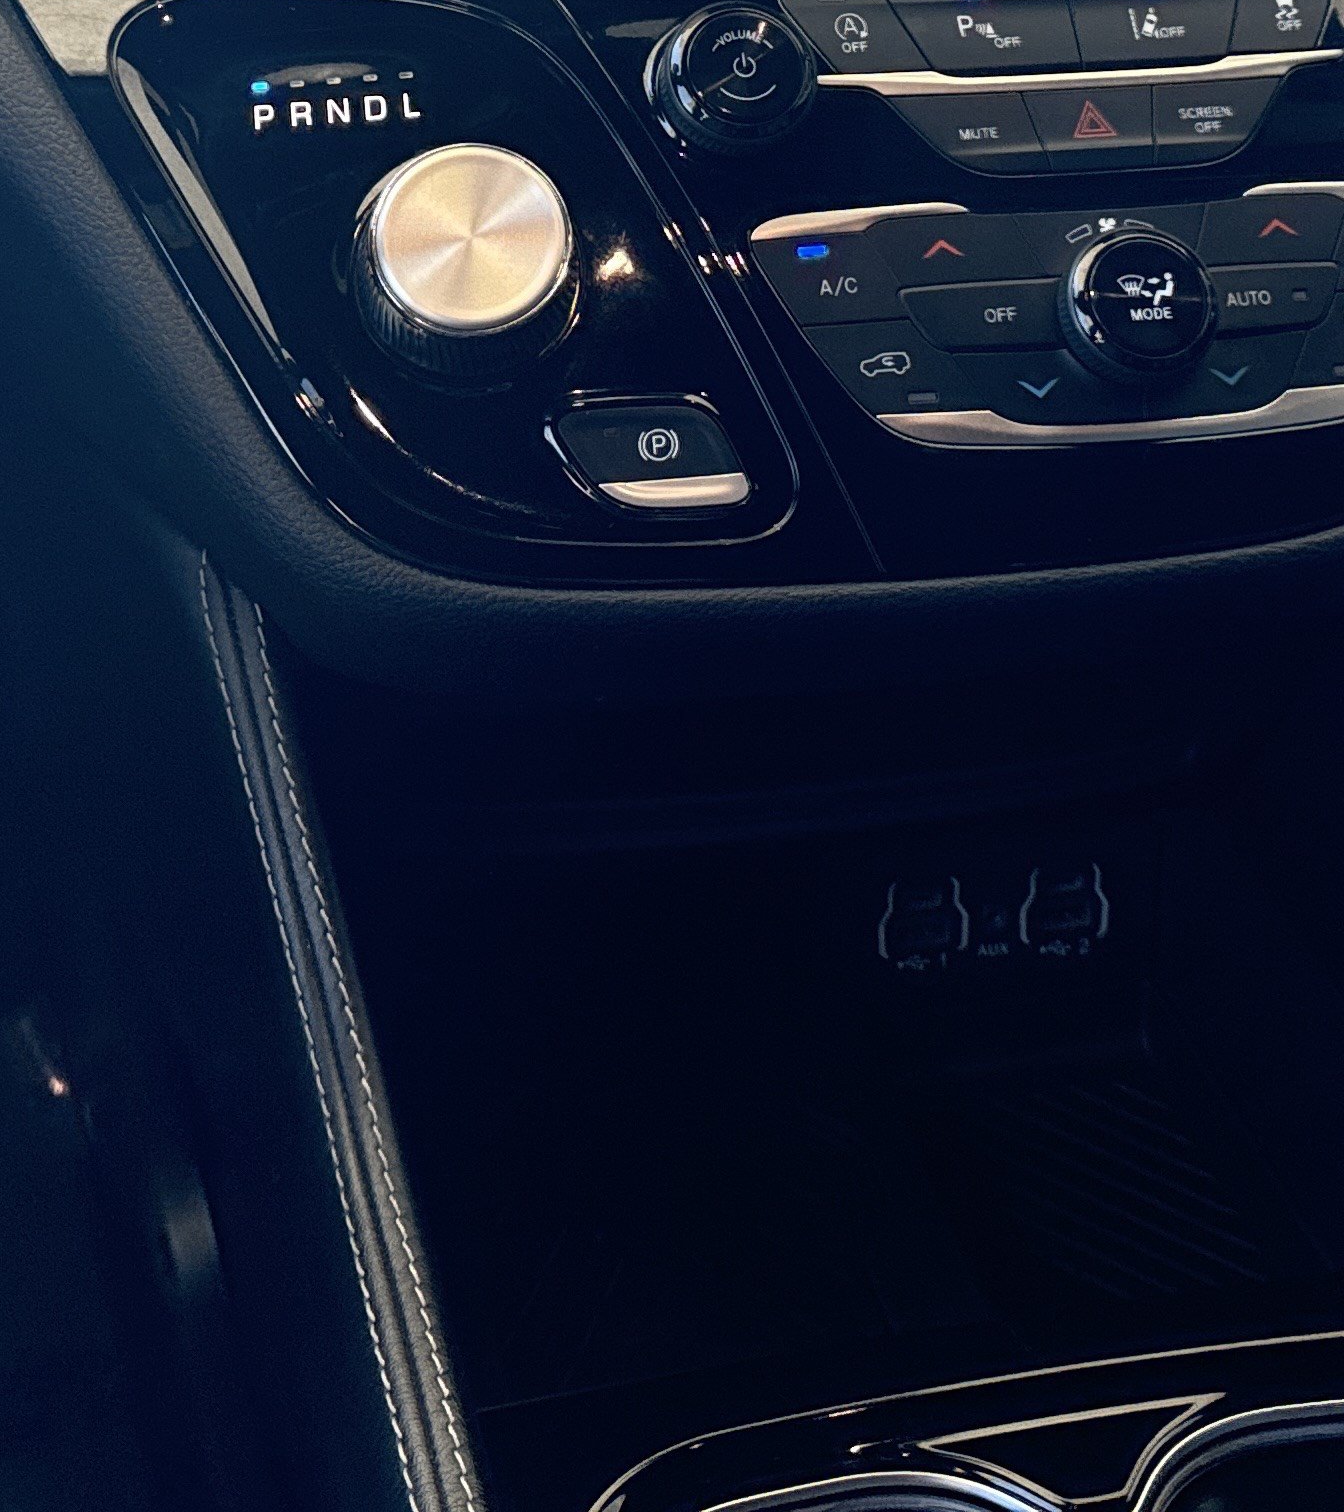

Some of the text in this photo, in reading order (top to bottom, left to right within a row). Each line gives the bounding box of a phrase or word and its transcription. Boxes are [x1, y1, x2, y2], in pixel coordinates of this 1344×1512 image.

[1159, 25, 1186, 39] OFF
[1276, 19, 1303, 32] OFF
[716, 29, 764, 46] VOLUME
[994, 35, 1022, 49] OFF
[841, 39, 869, 54] OFF
[253, 92, 421, 130] P R N D L
[1177, 106, 1234, 120] SCREEN
[958, 126, 1000, 140] MUTE
[1194, 121, 1223, 134] OFF
[819, 276, 858, 298] A/C
[1226, 290, 1273, 307] AUTO
[983, 306, 1018, 324] OFF
[1130, 306, 1174, 322] MODE
